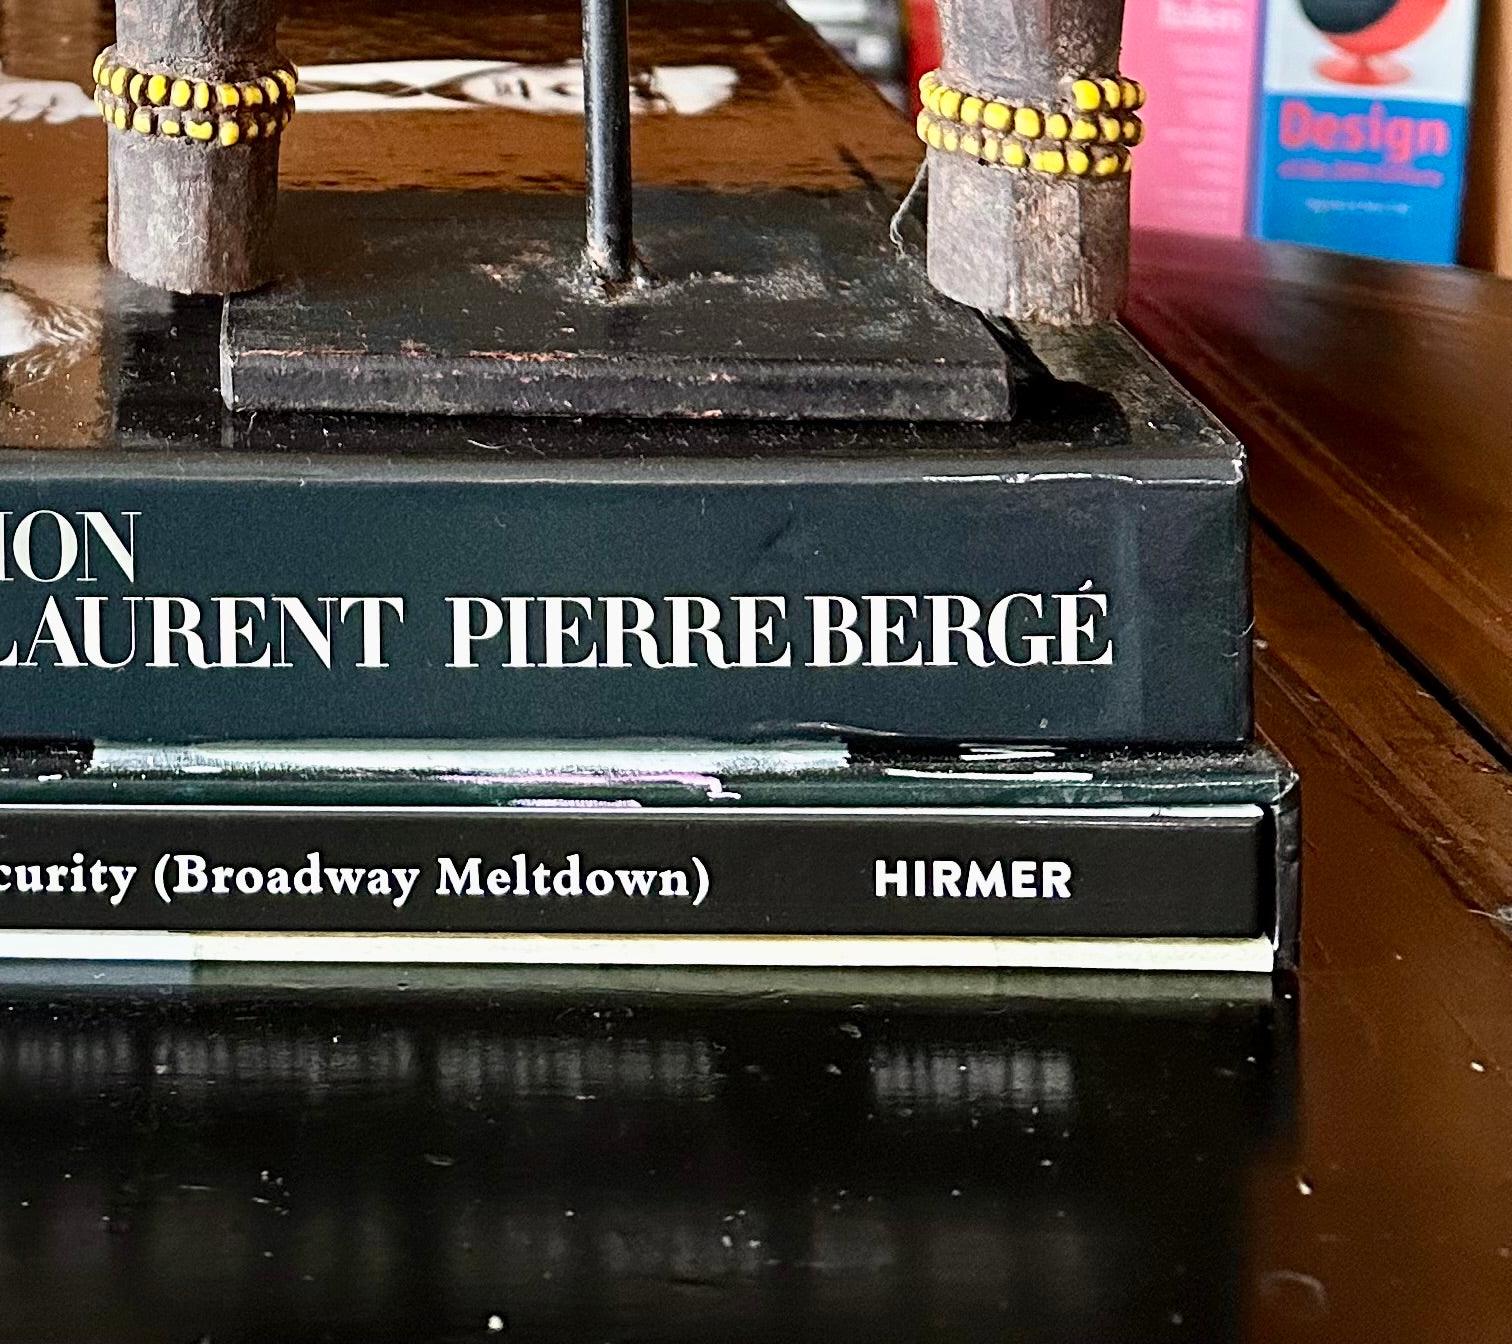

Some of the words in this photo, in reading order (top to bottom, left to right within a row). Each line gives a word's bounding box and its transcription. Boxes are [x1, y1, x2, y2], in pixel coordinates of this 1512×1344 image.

[1279, 98, 1451, 165] Design
[444, 595, 792, 670] PIERRE
[804, 578, 1116, 668] BERGÉ
[152, 852, 420, 909] (Broadway
[432, 854, 713, 909] Meltdown)
[874, 859, 1073, 899] HIRMER
